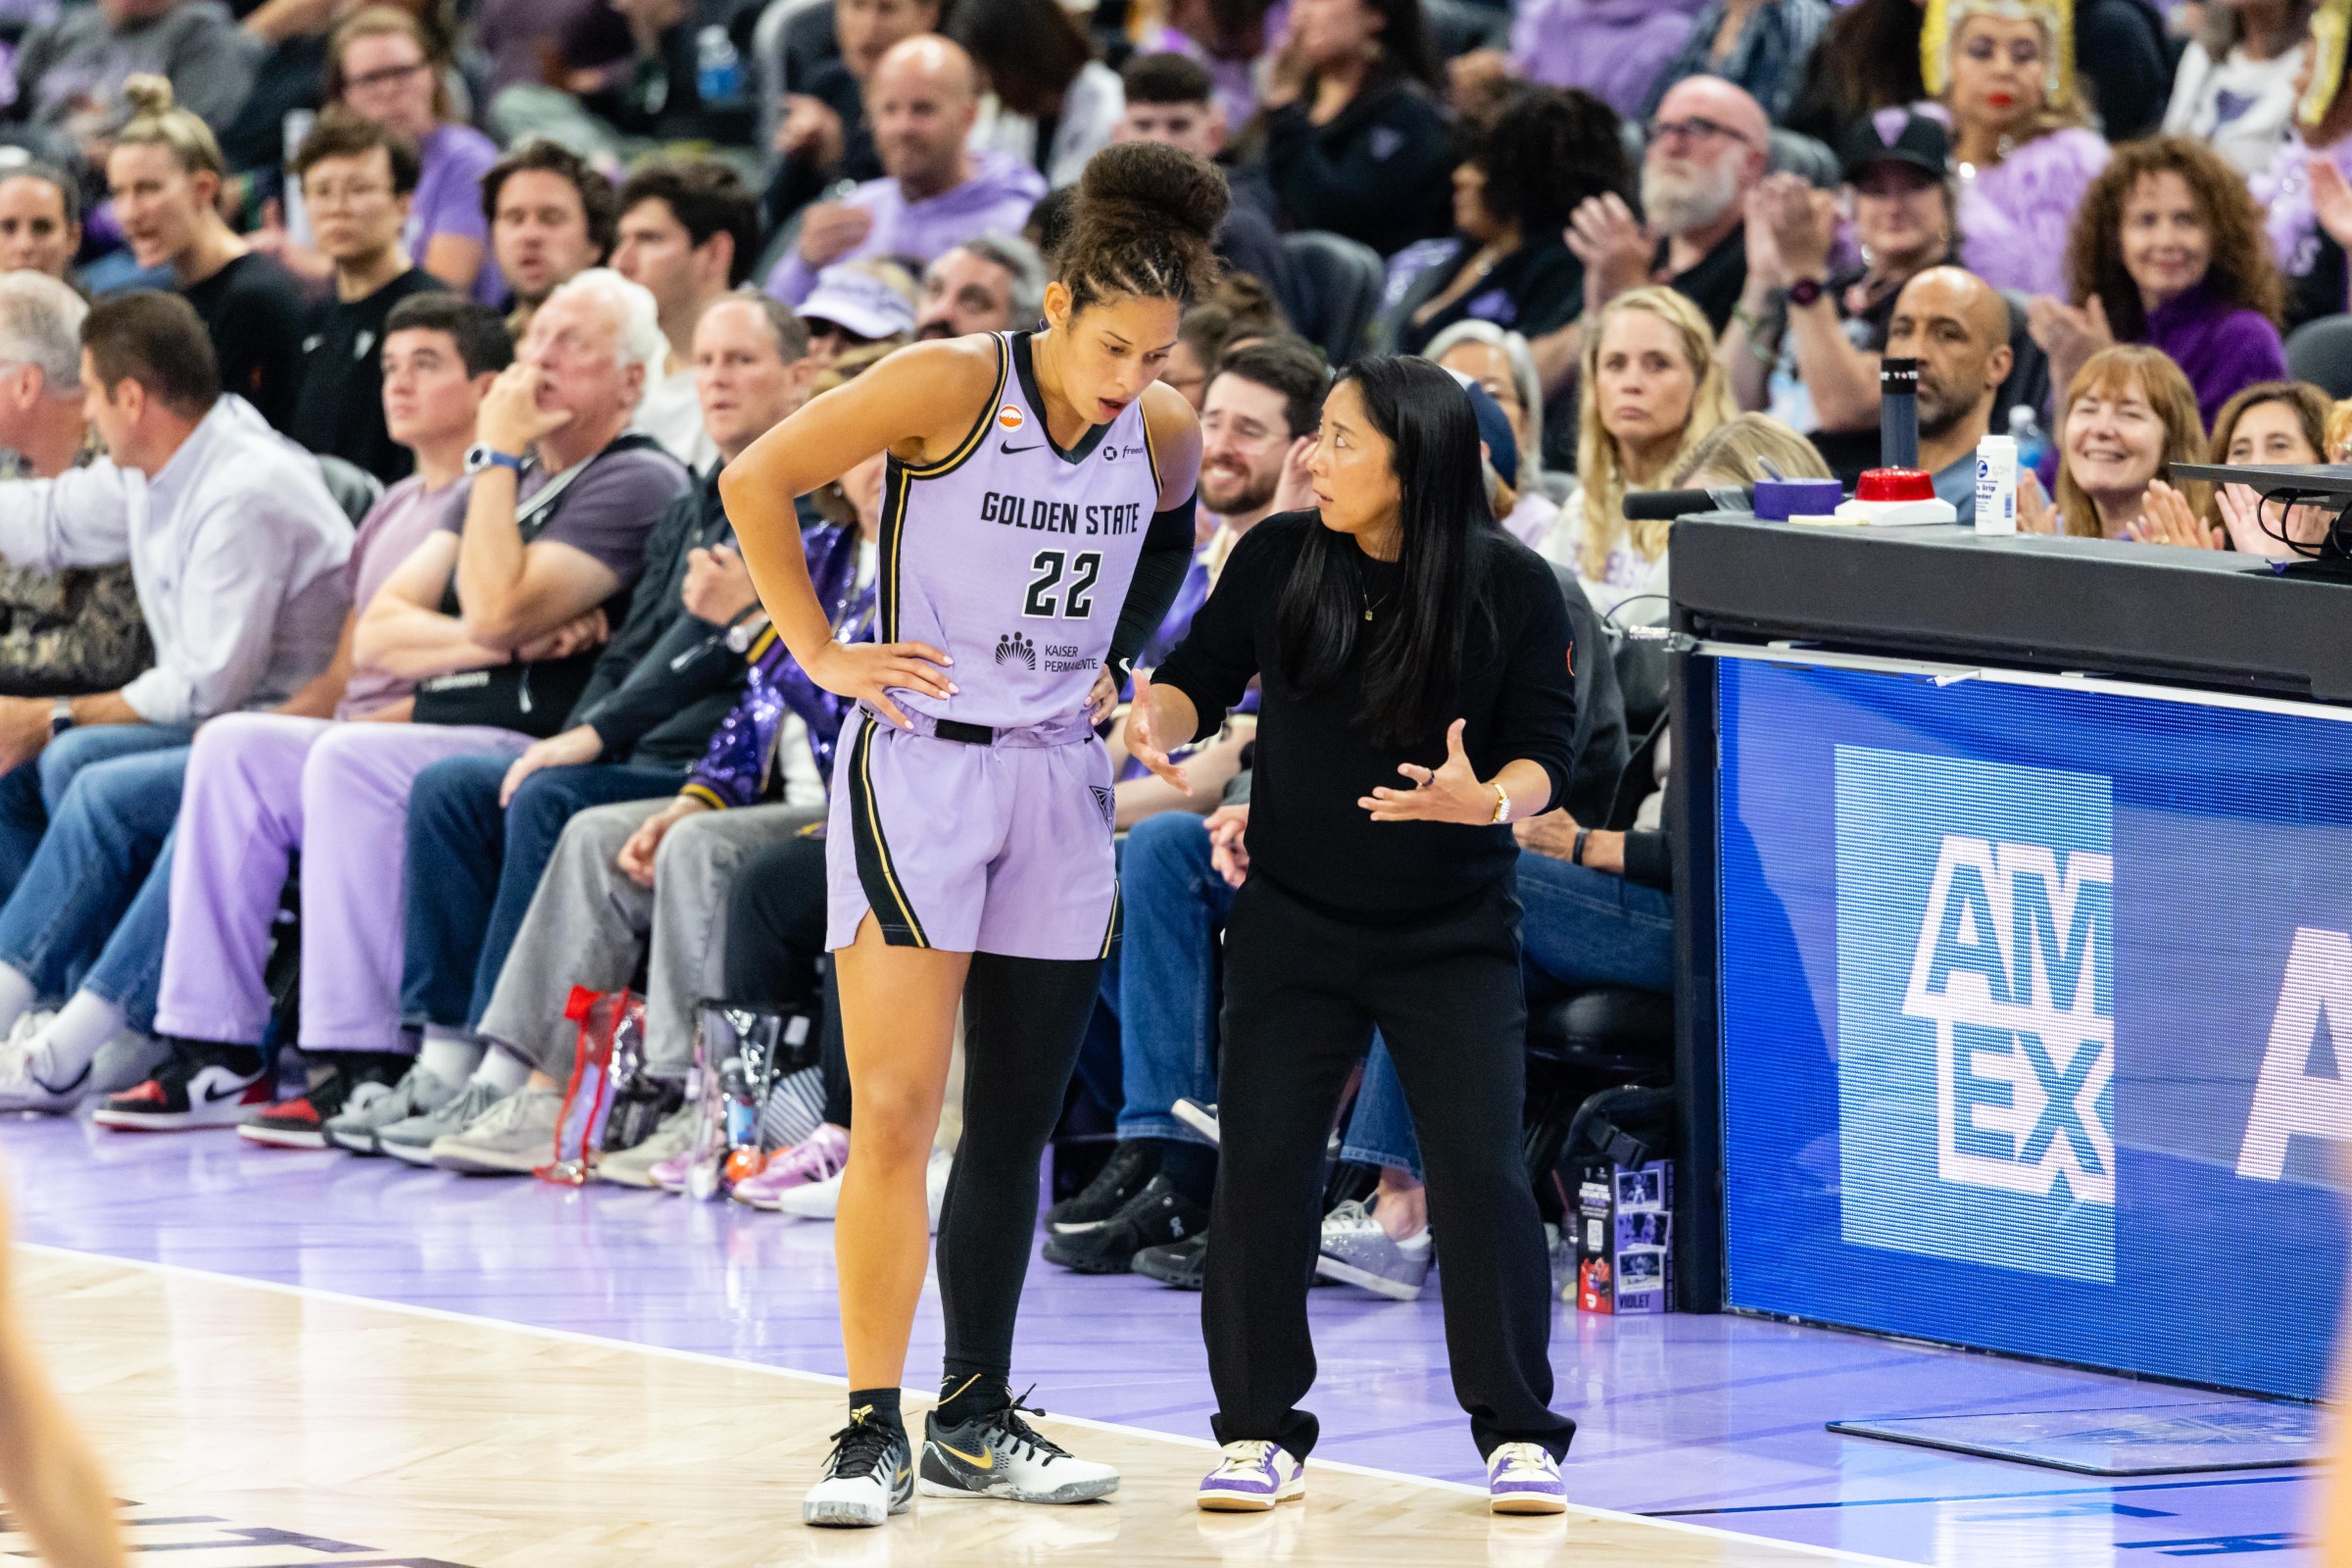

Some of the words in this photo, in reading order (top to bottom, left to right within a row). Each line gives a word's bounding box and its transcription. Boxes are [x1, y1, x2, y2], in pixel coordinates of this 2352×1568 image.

[980, 491, 1078, 535] GOLDEN
[1085, 502, 1140, 535] STATE
[1021, 548, 1103, 620] 22
[1044, 644, 1079, 658] KAISER
[1618, 1293, 1650, 1308] VIOLET
